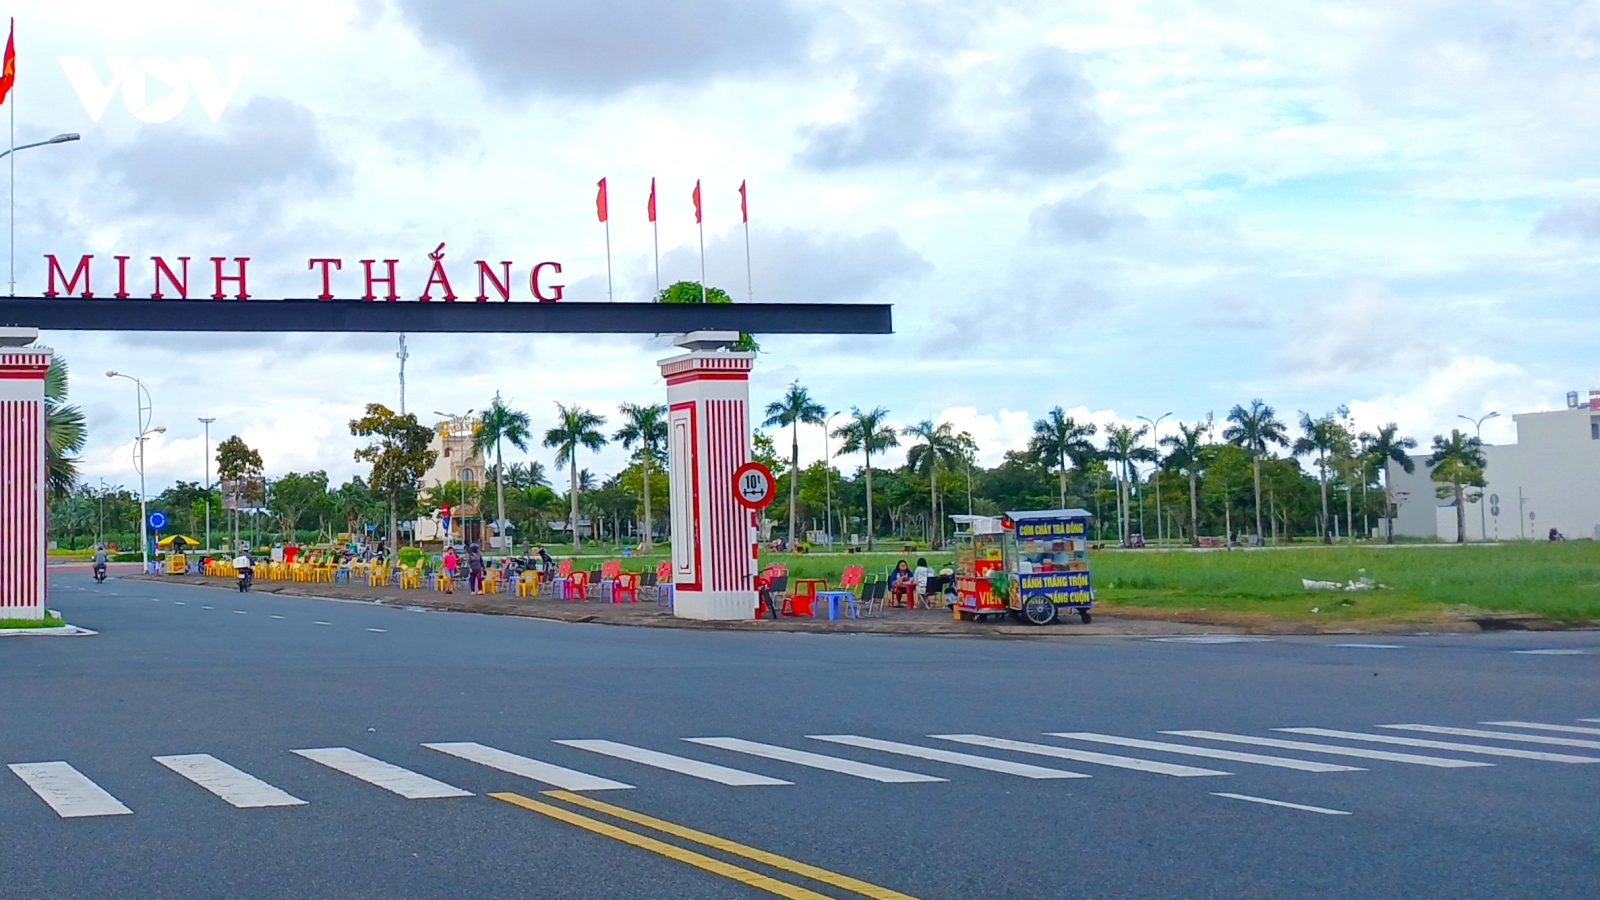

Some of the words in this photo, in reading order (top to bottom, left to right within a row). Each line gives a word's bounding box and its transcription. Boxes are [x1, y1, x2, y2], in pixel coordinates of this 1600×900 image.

[43, 254, 251, 299] MINH
[308, 242, 565, 301] THẮNG
[1022, 576, 1042, 588] BÁNH
[1043, 574, 1068, 587] TRÁNG
[1069, 573, 1089, 588] TRỘN
